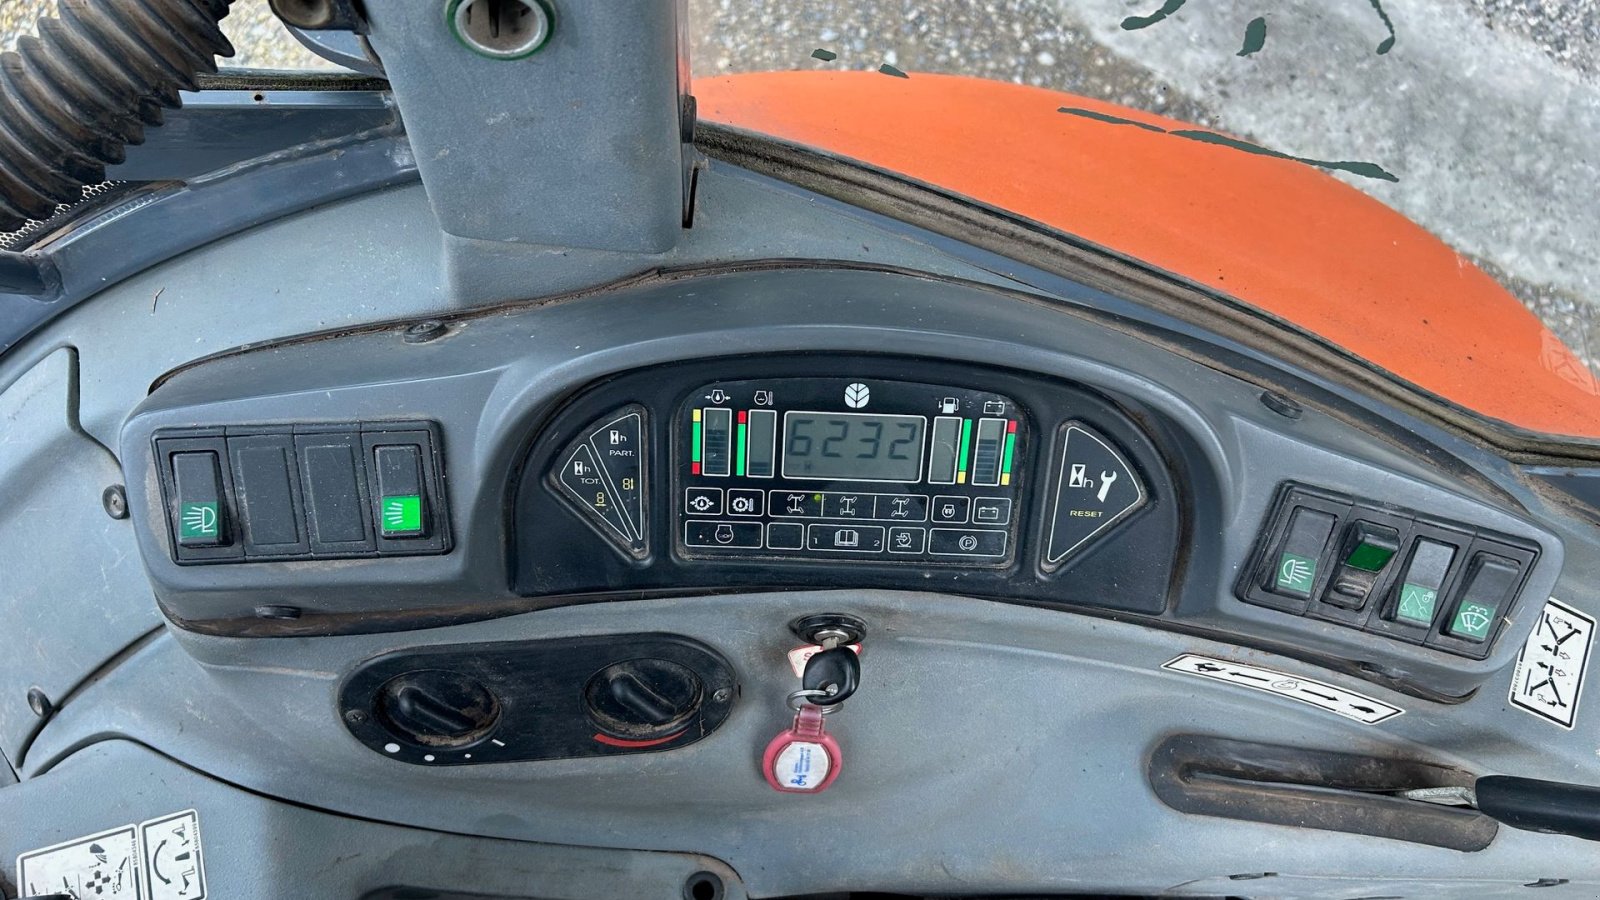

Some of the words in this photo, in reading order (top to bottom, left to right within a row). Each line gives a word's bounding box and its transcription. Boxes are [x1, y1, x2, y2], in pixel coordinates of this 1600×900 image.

[788, 420, 917, 460] 6232
[609, 449, 635, 457] PART.
[580, 477, 601, 485] TOT.
[1083, 477, 1094, 488] h
[1069, 510, 1104, 518] RESET
[813, 537, 818, 545] 1
[873, 539, 880, 547] 2
[964, 539, 972, 547] P
